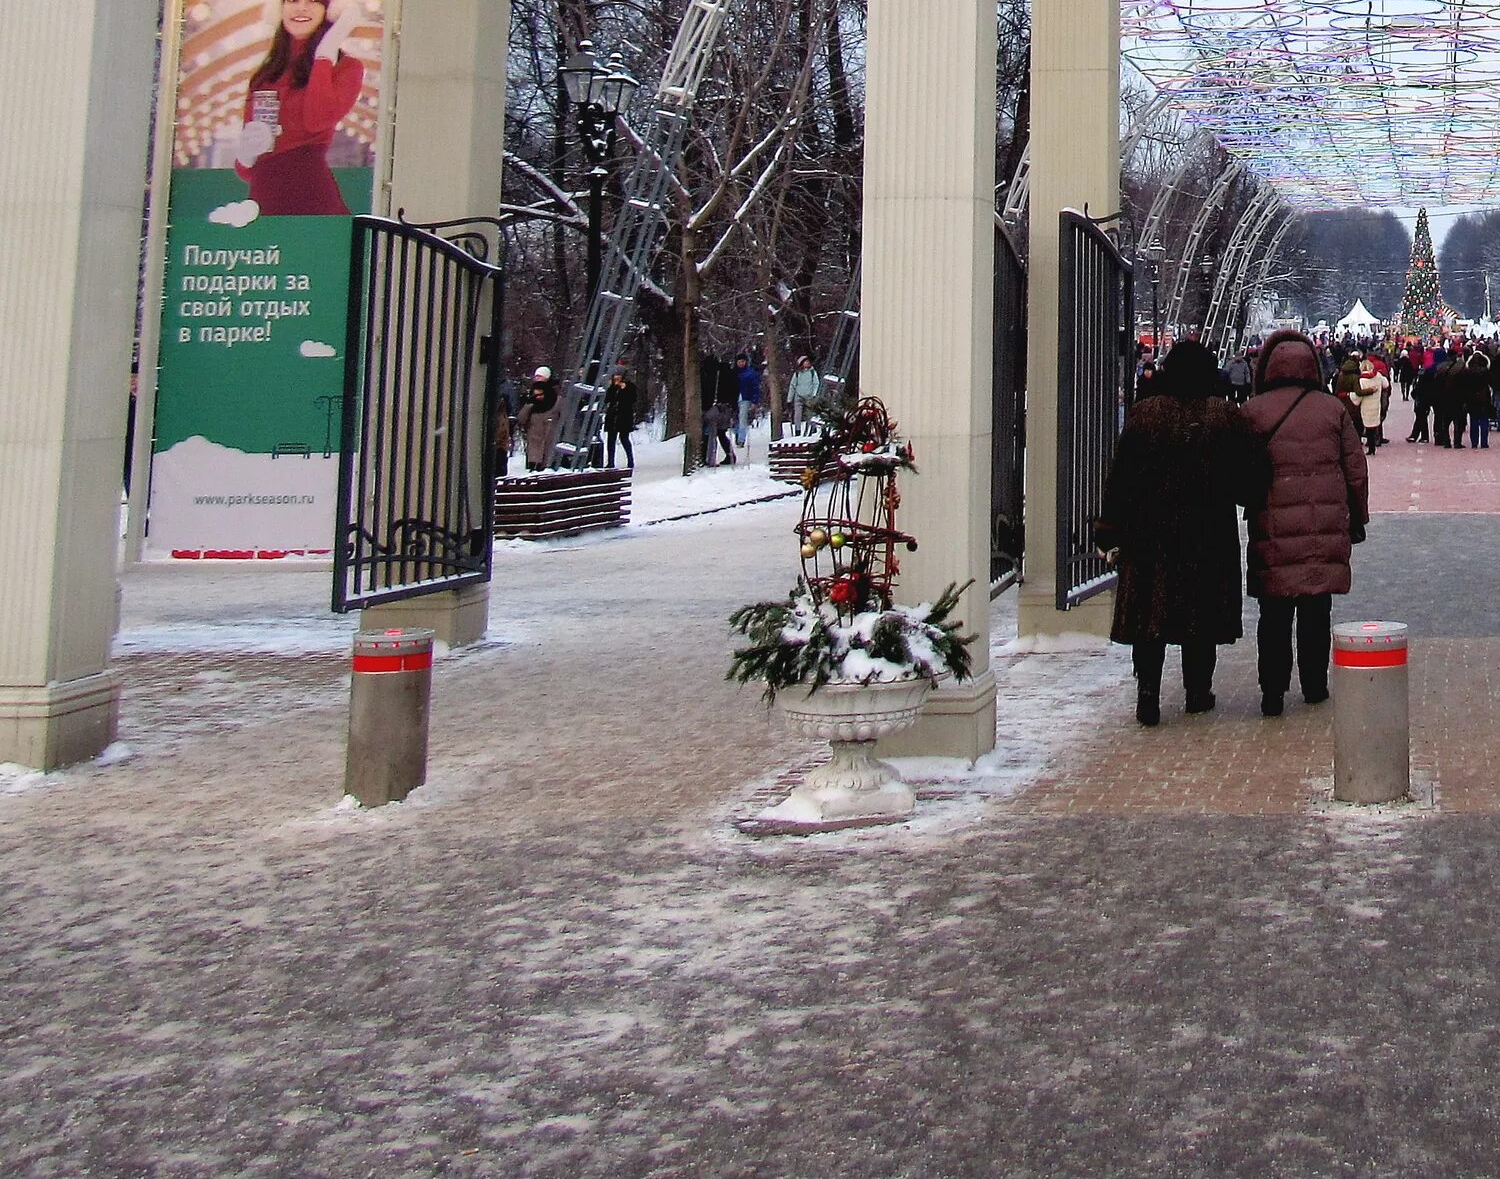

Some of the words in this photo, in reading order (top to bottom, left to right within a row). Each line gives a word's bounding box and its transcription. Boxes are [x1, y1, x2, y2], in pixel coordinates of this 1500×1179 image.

[184, 244, 281, 271] Получай
[182, 275, 277, 295] подарки
[285, 275, 310, 291] за
[180, 297, 232, 317] свой
[240, 300, 311, 319] отдых
[179, 327, 192, 342] в
[200, 322, 272, 348] парке!
[194, 494, 315, 507] www.parkseason.ru
